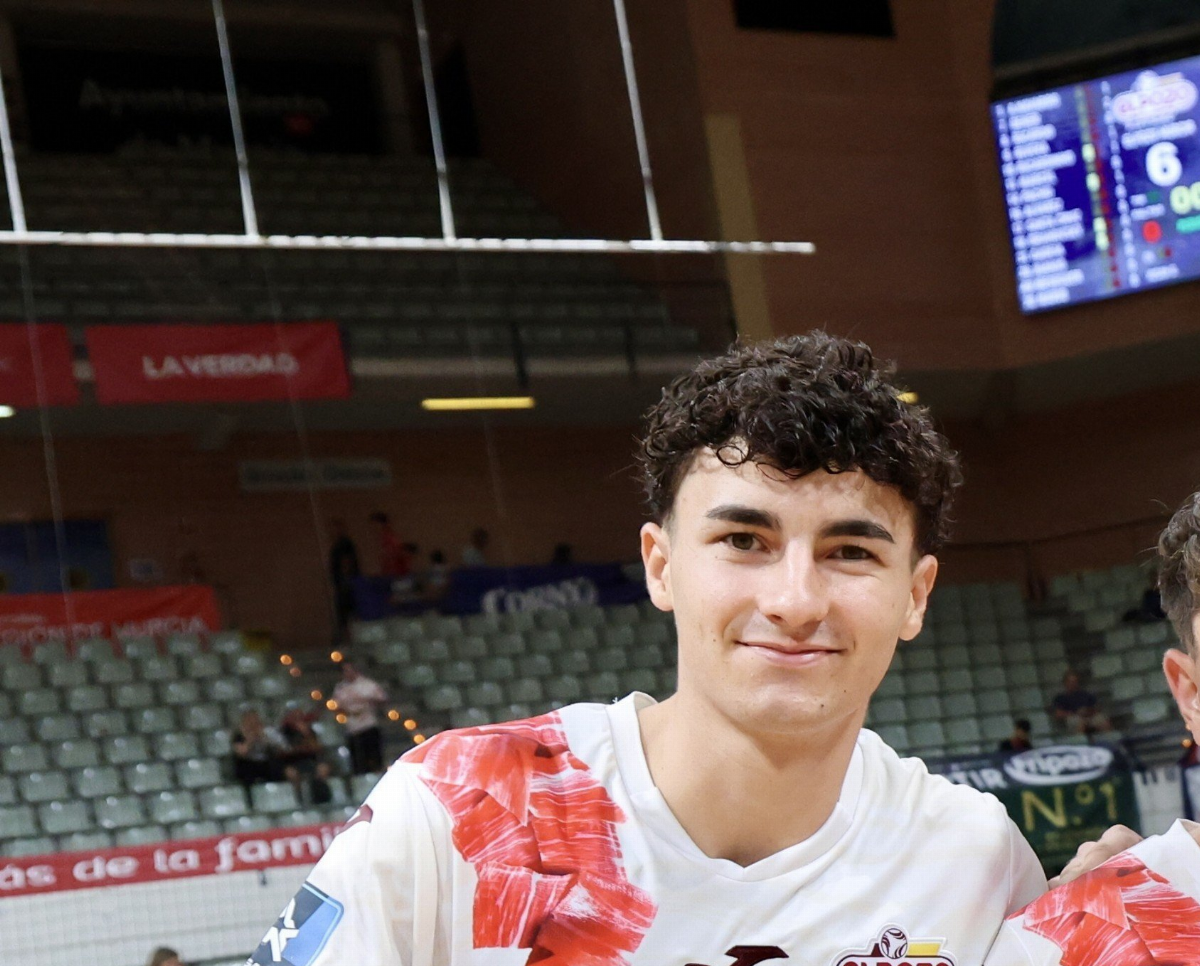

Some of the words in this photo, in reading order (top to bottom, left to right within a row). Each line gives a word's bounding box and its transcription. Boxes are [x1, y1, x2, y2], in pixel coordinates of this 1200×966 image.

[1146, 142, 1182, 187] 6
[142, 354, 184, 379] LA
[181, 352, 299, 379] VERDAD
[0, 863, 56, 890] ás
[73, 856, 139, 882] de
[154, 849, 200, 873] la
[214, 826, 339, 874] fami
